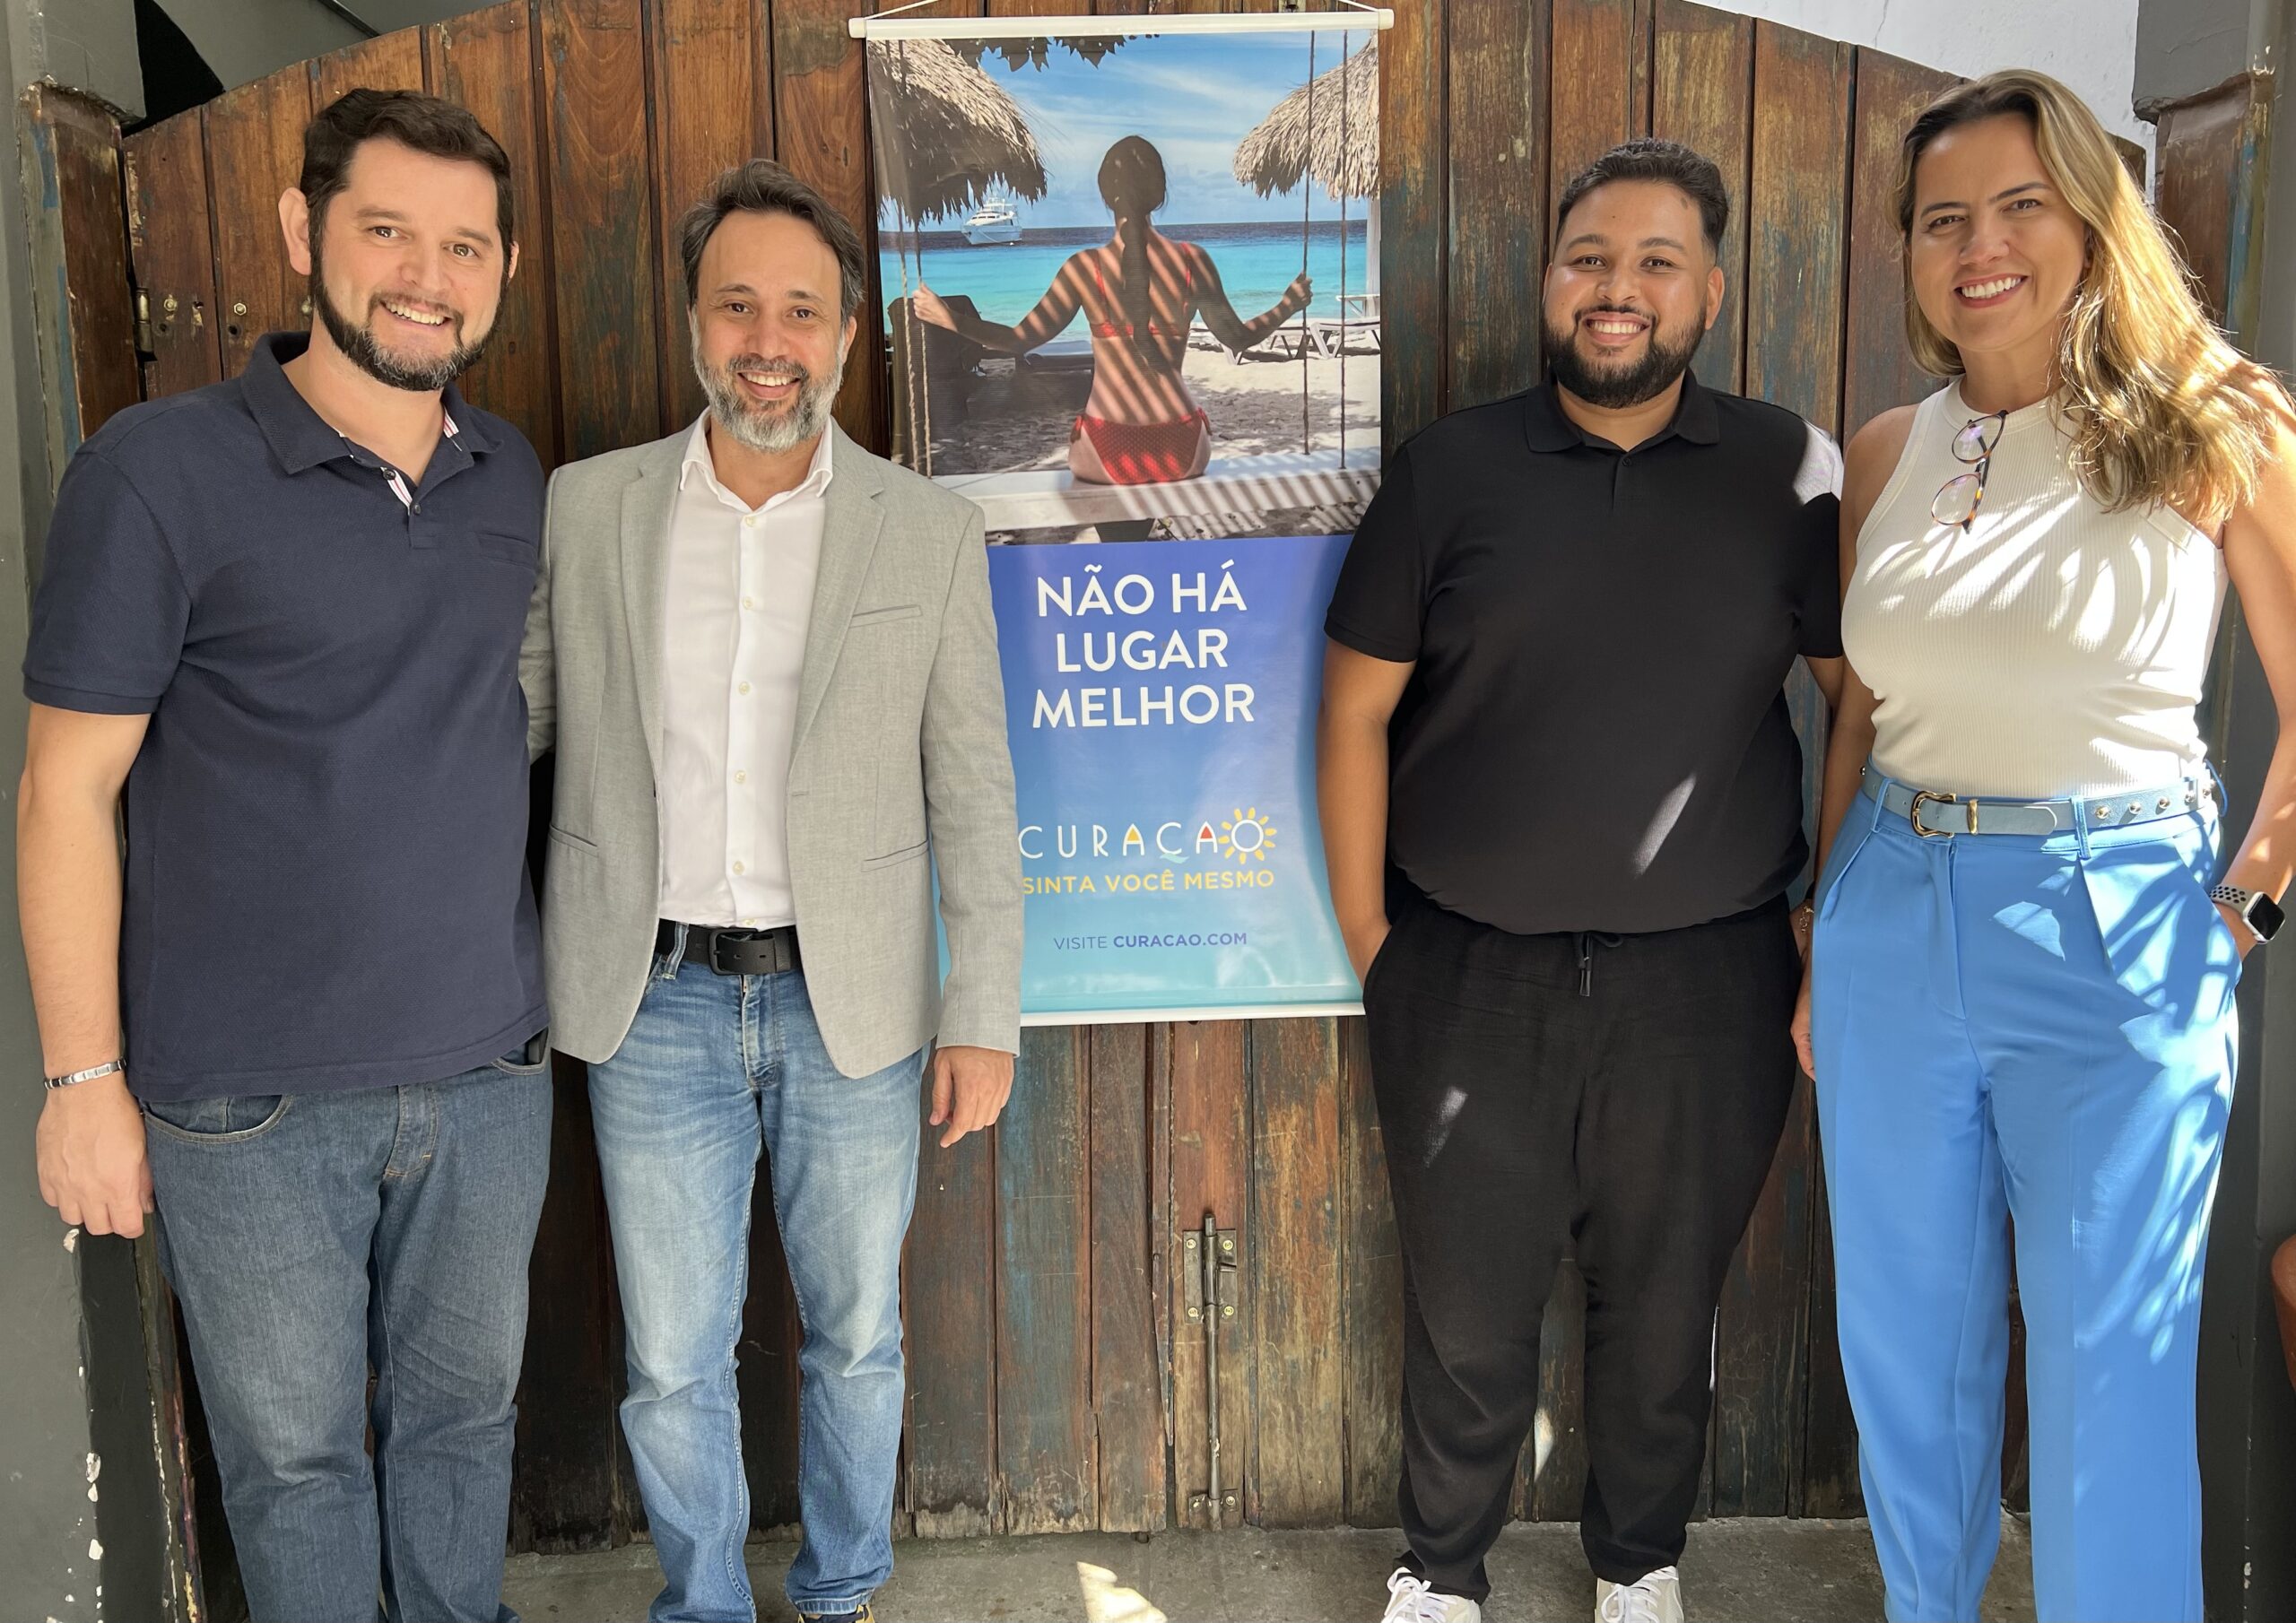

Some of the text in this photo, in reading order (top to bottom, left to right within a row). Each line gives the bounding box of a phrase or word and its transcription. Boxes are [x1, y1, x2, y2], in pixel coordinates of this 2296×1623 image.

[1037, 559, 1248, 617] NÃO HÁ
[1056, 628, 1229, 673] LUGAR
[1031, 682, 1255, 729] MELHOR
[1018, 817, 1265, 864] CURAÇAO
[1022, 869, 1274, 895] SINTA VOCÊ MESMO
[1054, 933, 1248, 950] VISITE CURACAO.COM
